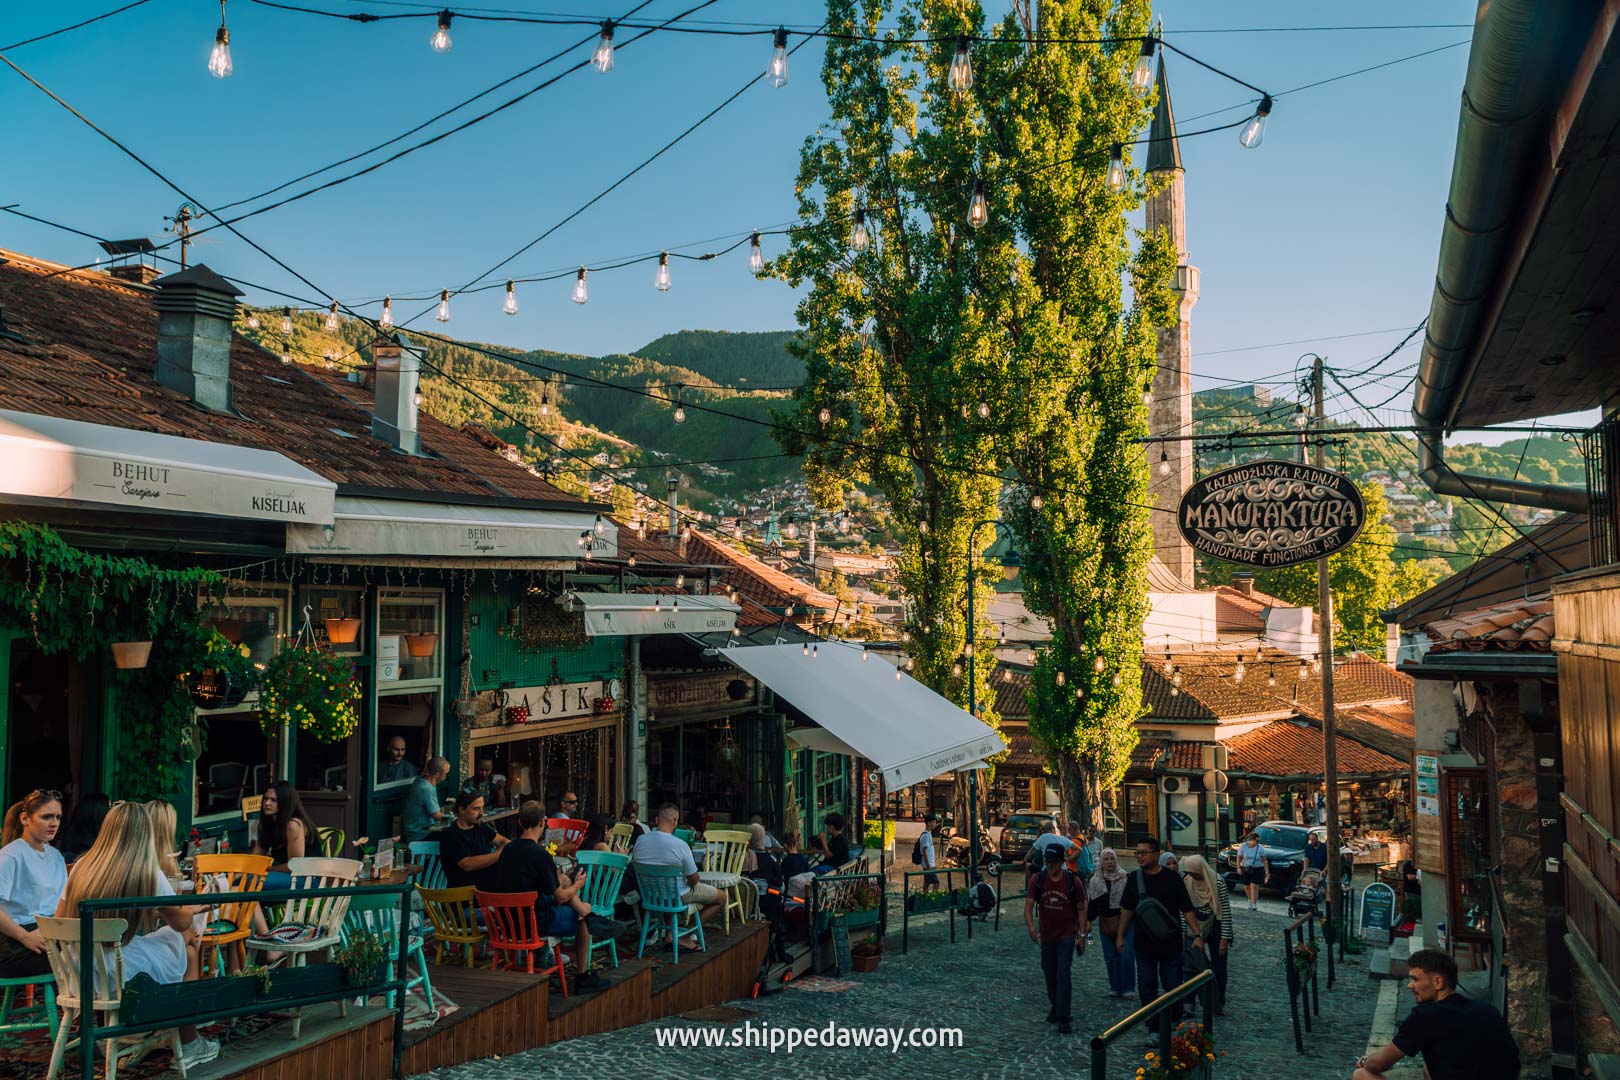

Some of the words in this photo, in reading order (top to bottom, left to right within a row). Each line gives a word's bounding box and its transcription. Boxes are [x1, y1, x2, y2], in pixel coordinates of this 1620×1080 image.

[113, 461, 170, 484] BEHUT
[1205, 464, 1289, 493] KAZANDŽIJSKA
[1293, 467, 1340, 490] RADNJA
[252, 496, 306, 515] KISELJAK
[1185, 499, 1358, 528] MANUFAKTURA
[467, 528, 498, 540] BEHUT
[1195, 537, 1258, 563] HANDMADE
[1262, 543, 1321, 565] FUNCTIONAL
[1323, 532, 1342, 549] ART
